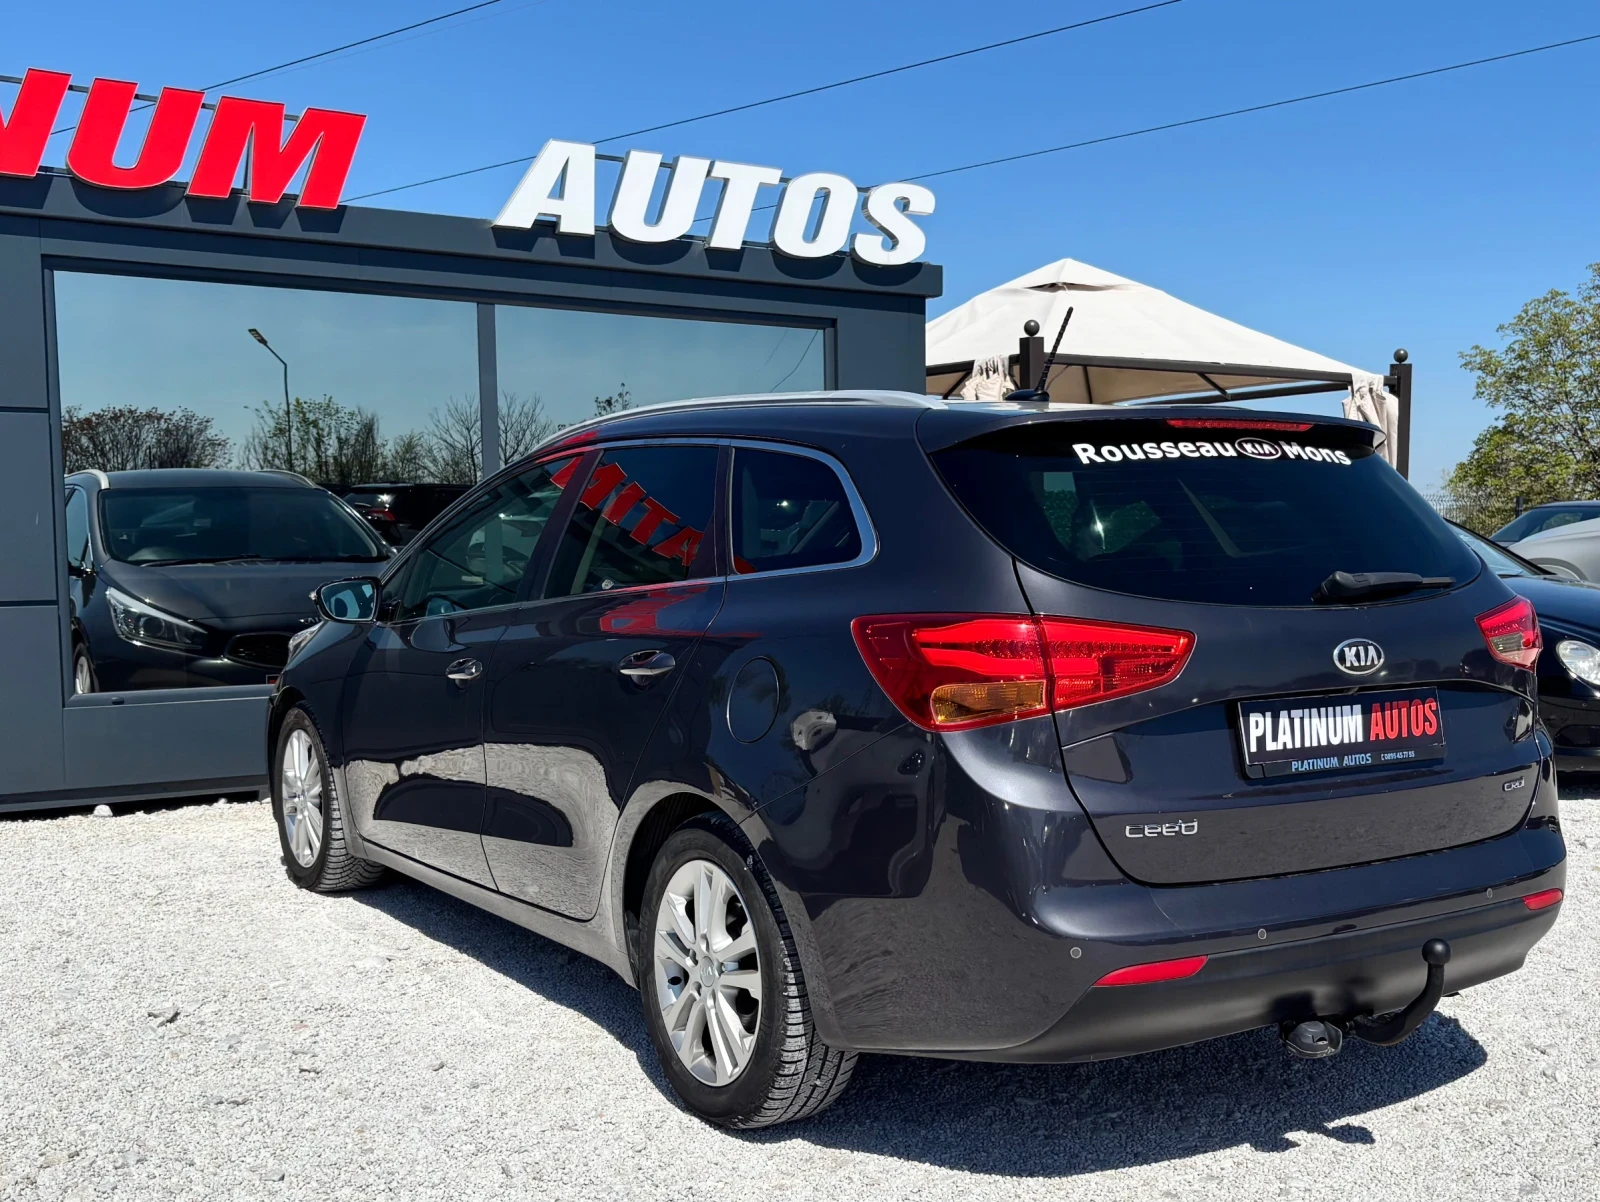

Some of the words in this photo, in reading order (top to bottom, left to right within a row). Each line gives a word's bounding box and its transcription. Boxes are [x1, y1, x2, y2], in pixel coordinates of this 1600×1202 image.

[492, 138, 936, 266] AUTOS
[1072, 441, 1237, 464] Rousseau
[1279, 440, 1352, 465] Mons
[1249, 704, 1363, 753] PLATINUM
[1370, 698, 1438, 741] AUTOS
[1291, 756, 1339, 772] PLATINUM
[1342, 753, 1372, 766] AUTOS
